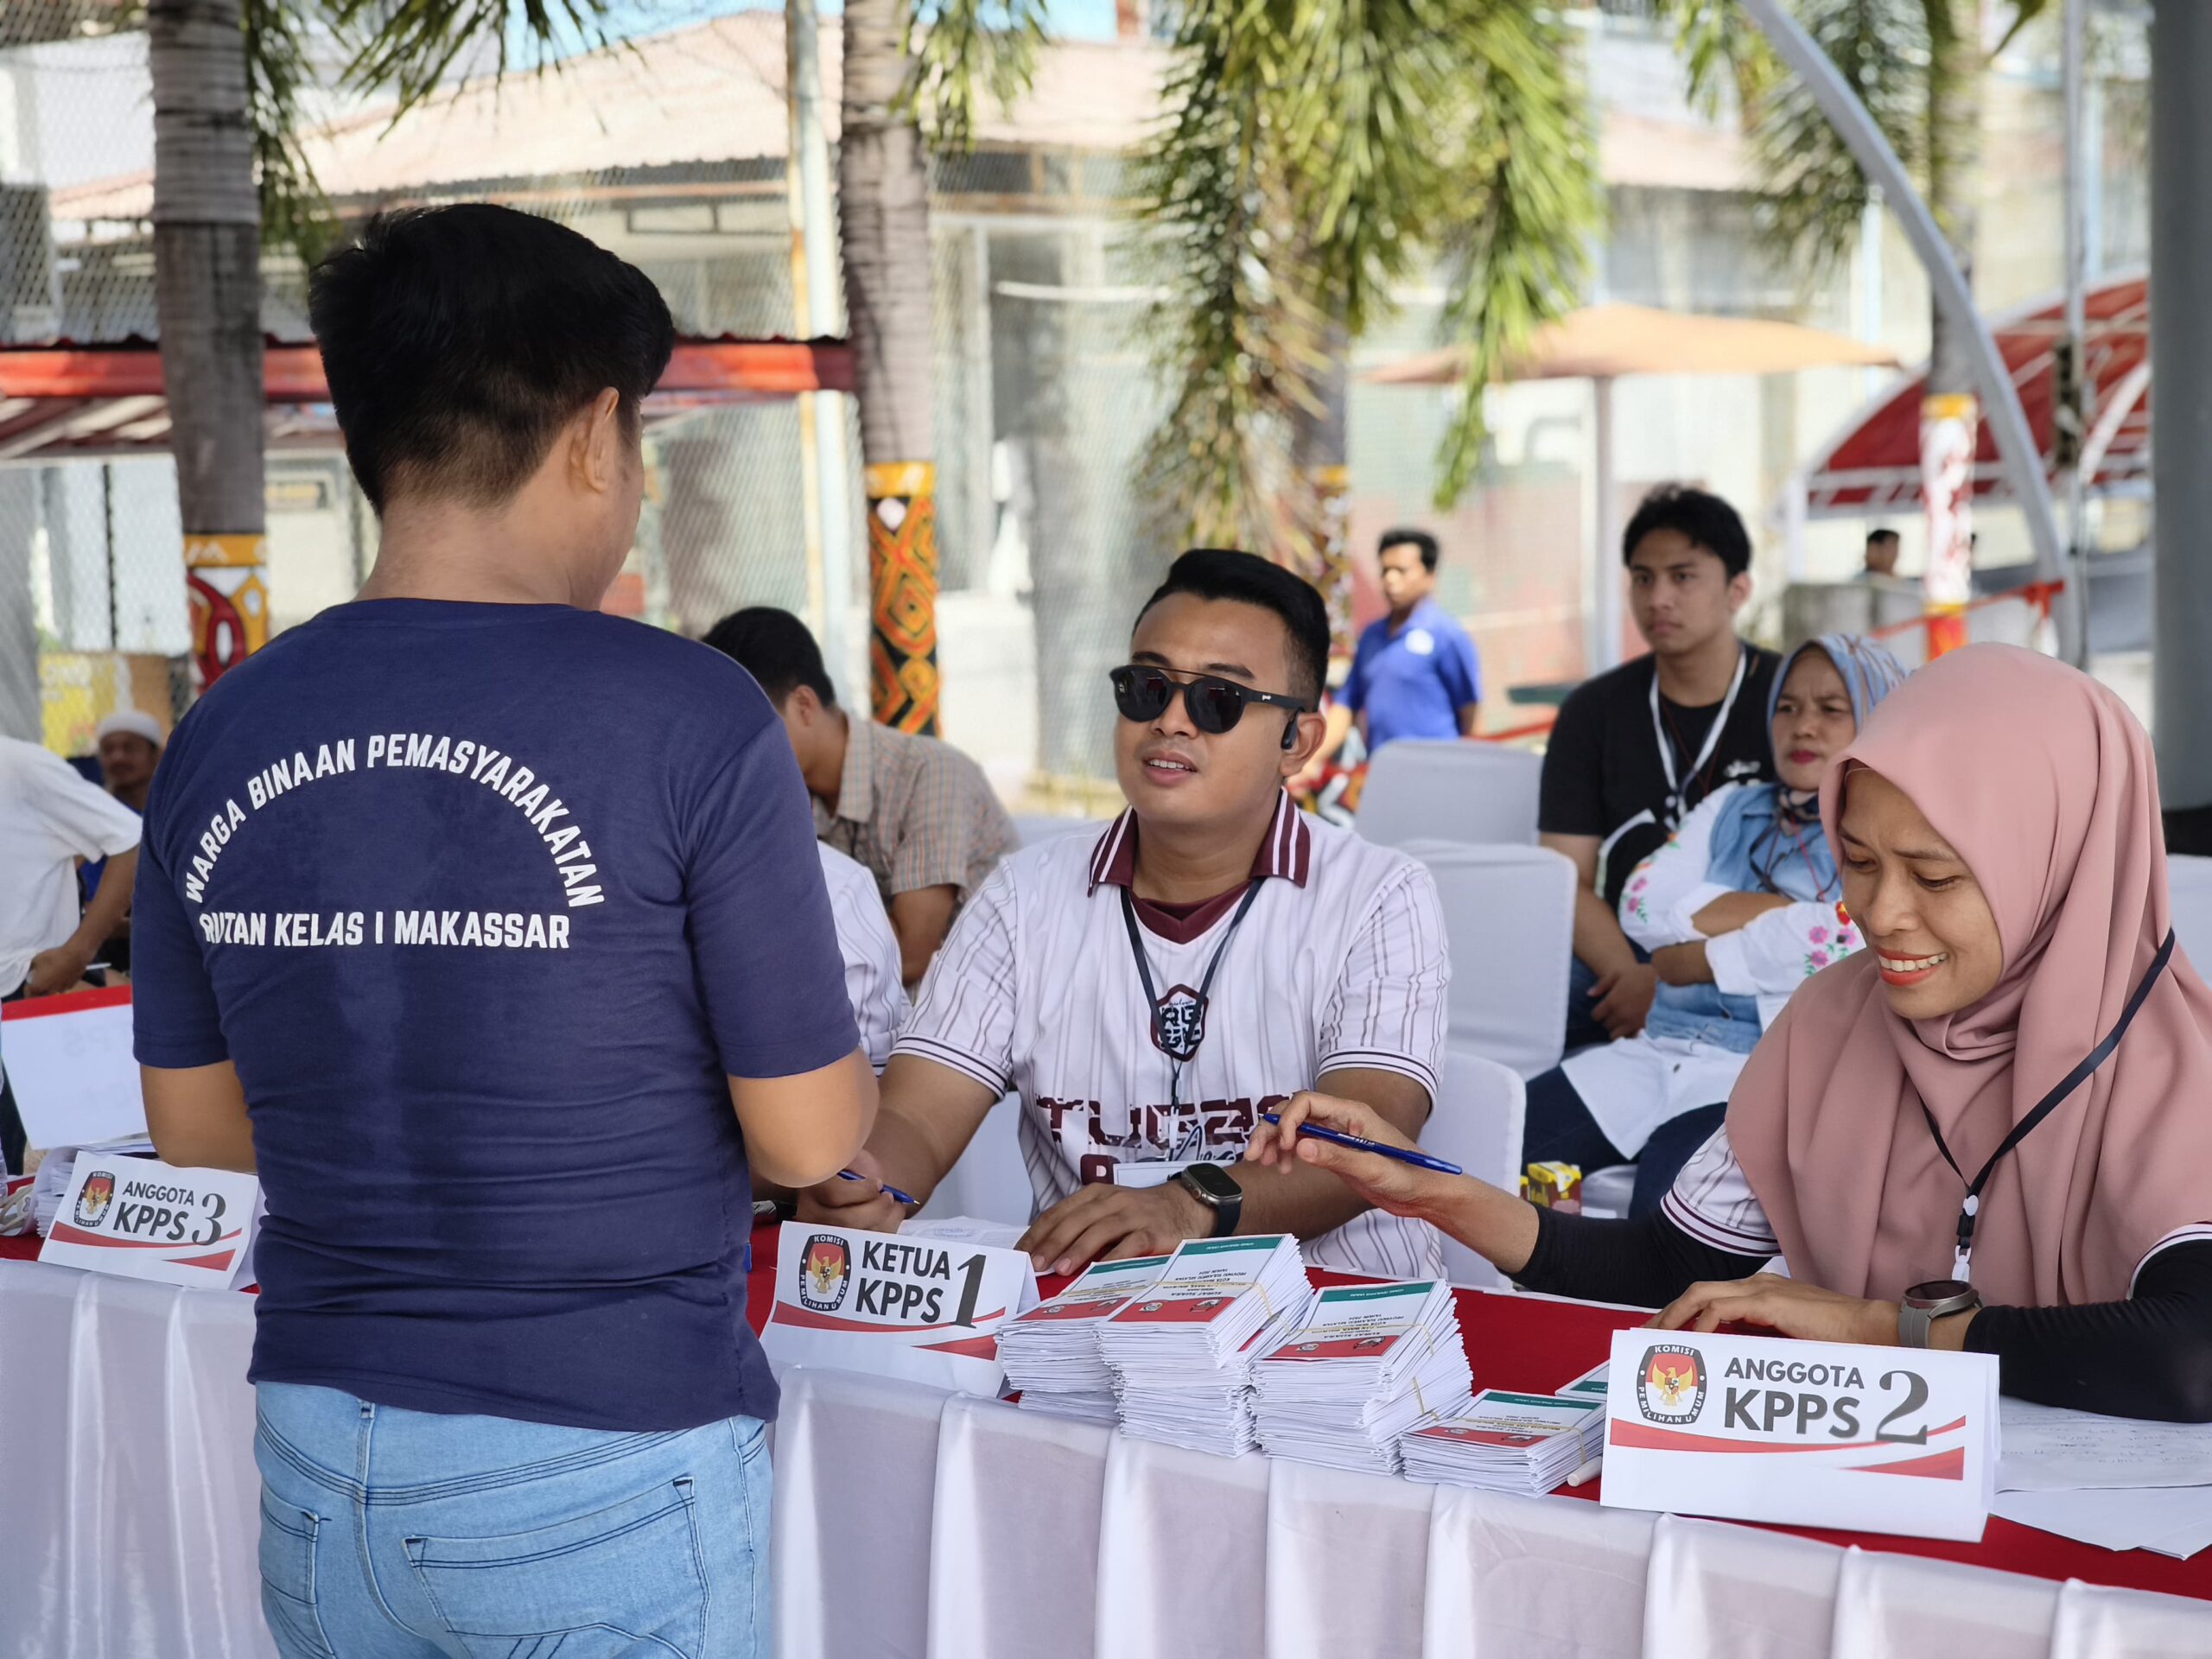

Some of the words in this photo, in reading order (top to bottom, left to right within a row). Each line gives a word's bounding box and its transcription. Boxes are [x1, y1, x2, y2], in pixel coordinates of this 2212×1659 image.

[186, 798, 247, 904] WARGA
[247, 739, 356, 810] BINAAN
[367, 733, 605, 907] PEMASYARAKATAN
[199, 912, 266, 946] RUTAN
[274, 911, 365, 947] KELAS
[374, 911, 384, 946] I
[395, 910, 570, 950] MAKASSAR
[122, 1180, 194, 1206] ANGGOTA
[113, 1202, 188, 1241] KPPS
[192, 1193, 226, 1246] 3
[814, 1235, 844, 1246] KOMISI
[861, 1240, 950, 1281] KETUA
[855, 1277, 944, 1324] KPPS
[952, 1254, 987, 1329] 1
[1654, 1344, 1695, 1357] KOMISI
[1724, 1357, 1865, 1389] ANGGOTA
[1724, 1387, 1860, 1439] KPPS
[1875, 1370, 1929, 1446] 2
